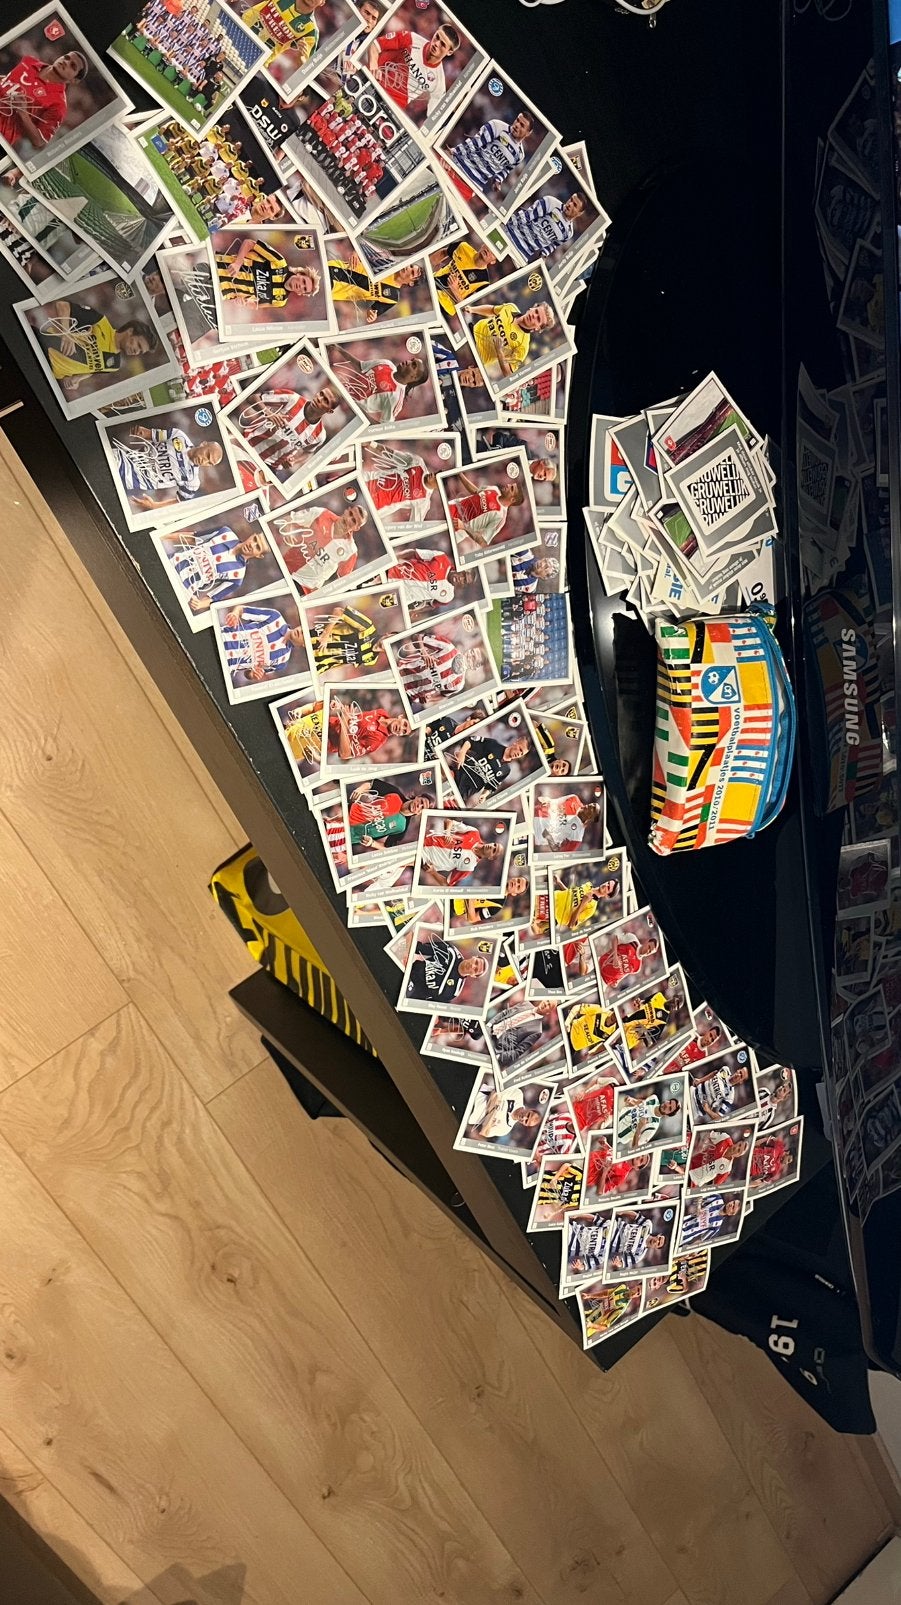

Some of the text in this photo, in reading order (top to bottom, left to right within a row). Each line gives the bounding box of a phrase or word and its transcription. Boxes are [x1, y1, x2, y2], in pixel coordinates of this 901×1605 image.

[250, 105, 283, 141] DSW
[841, 628, 860, 746] SAMSUNG
[708, 785, 723, 831] 2010/2011
[451, 838, 463, 860] ASR
[583, 1024, 594, 1044] SEACO
[769, 1315, 800, 1358] 19
